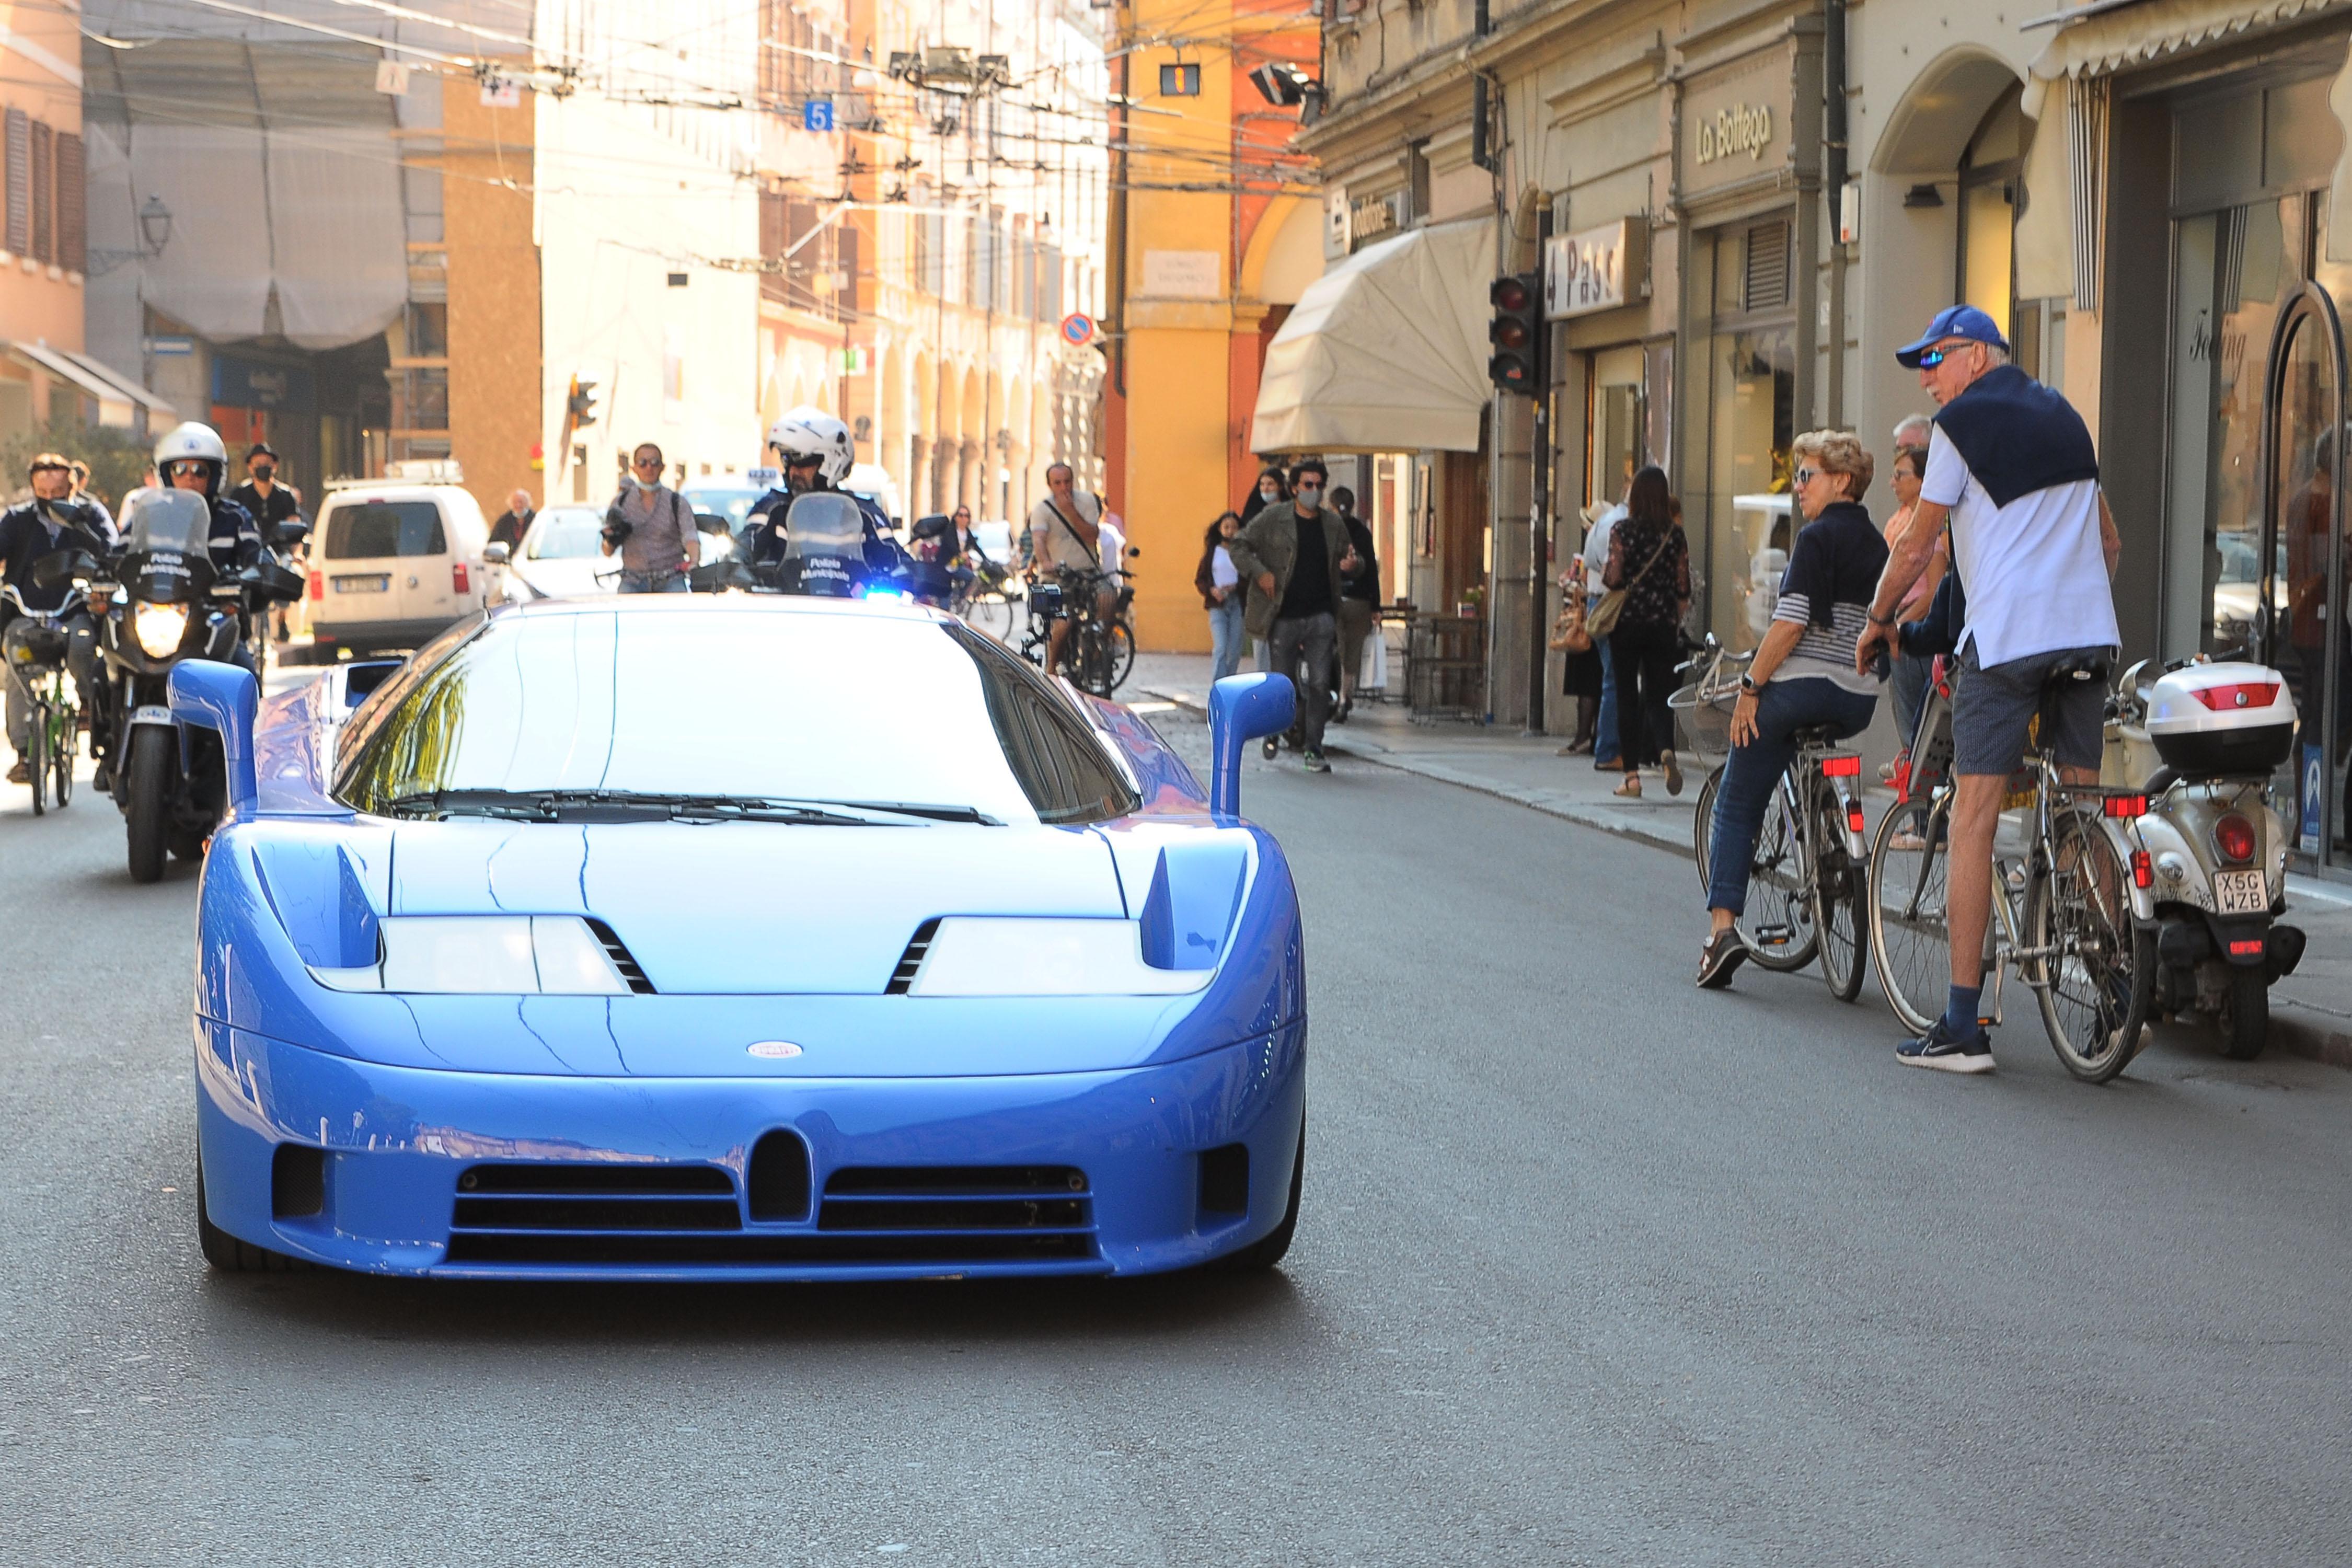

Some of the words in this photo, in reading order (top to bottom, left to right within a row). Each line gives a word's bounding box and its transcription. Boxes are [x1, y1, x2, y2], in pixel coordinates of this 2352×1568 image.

[811, 104, 826, 130] 5
[1696, 117, 1715, 165] La
[1716, 101, 1772, 161] Bottega
[810, 557, 841, 569] Polizia
[2224, 892, 2261, 909] WZB
